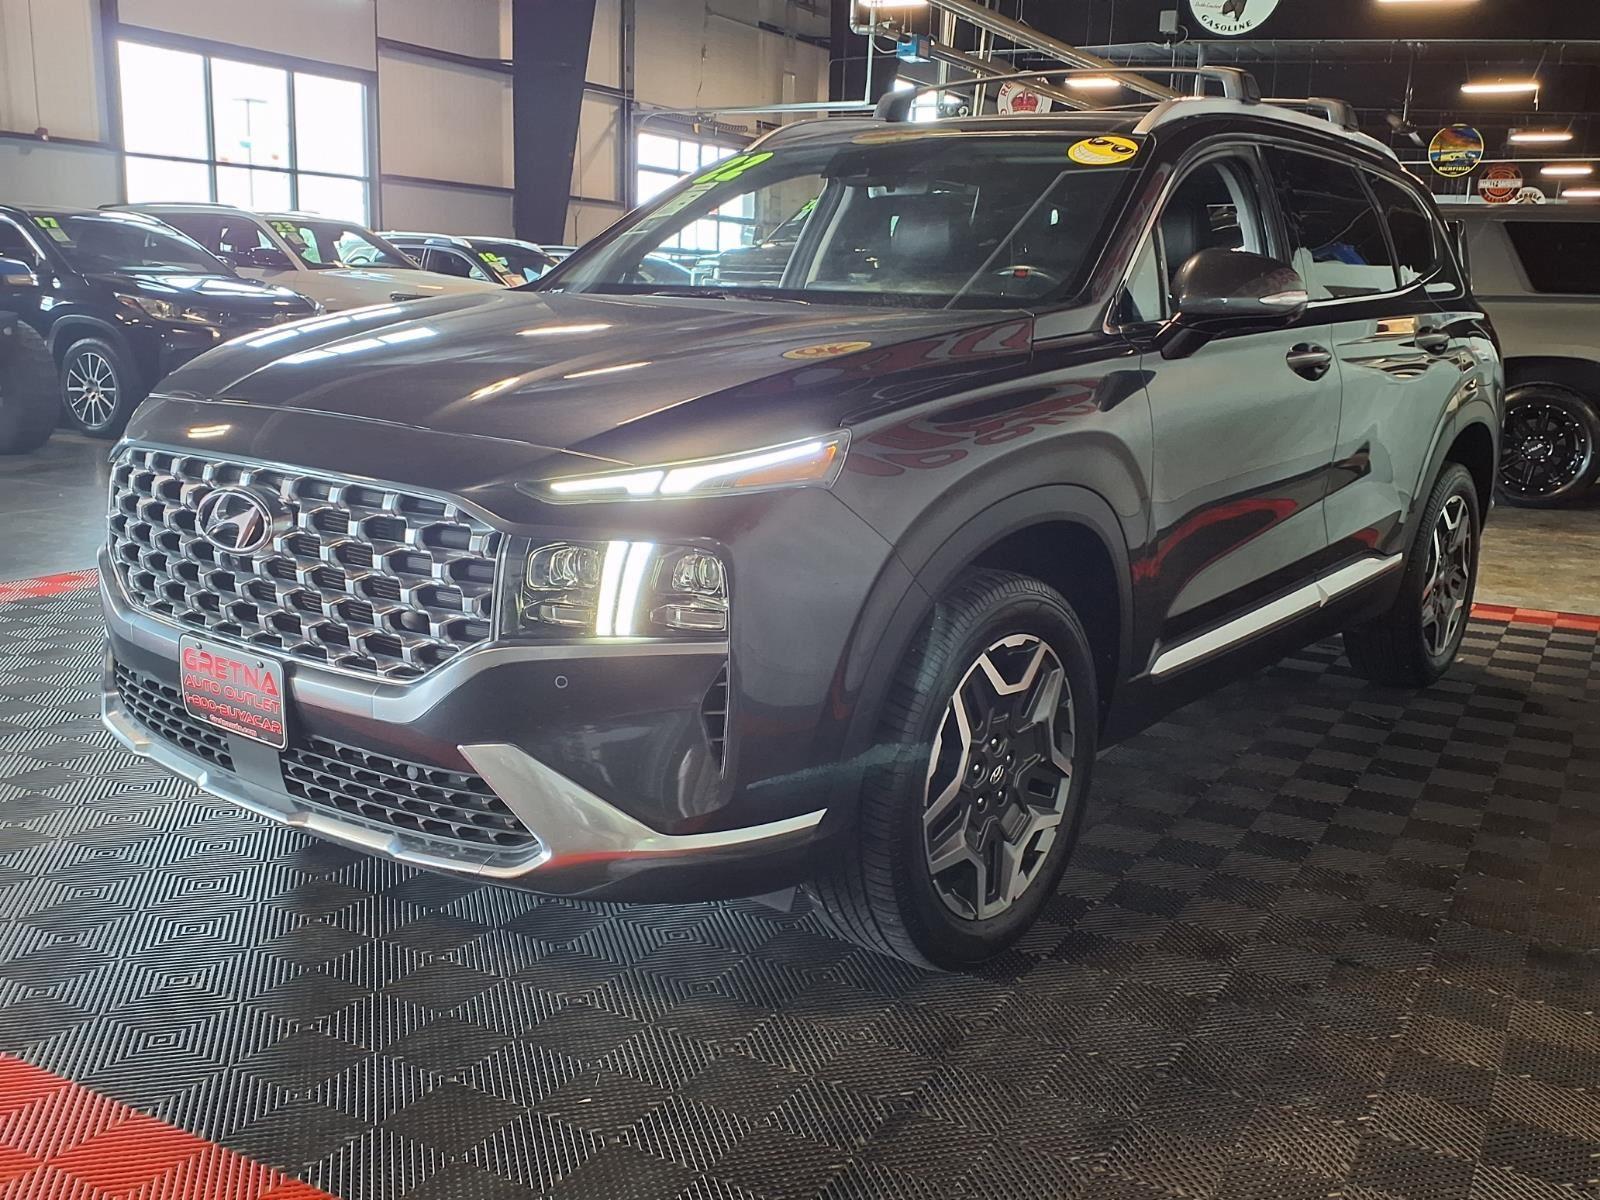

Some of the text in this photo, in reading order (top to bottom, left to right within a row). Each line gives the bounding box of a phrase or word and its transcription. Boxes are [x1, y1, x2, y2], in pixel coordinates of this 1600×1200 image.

[1201, 14, 1252, 31] GASOLINE
[34, 216, 59, 228] 17
[184, 647, 279, 696] GRETNA
[184, 673, 280, 714] AUTO OUTLET
[185, 691, 282, 734] 1-800-BUYACAR
